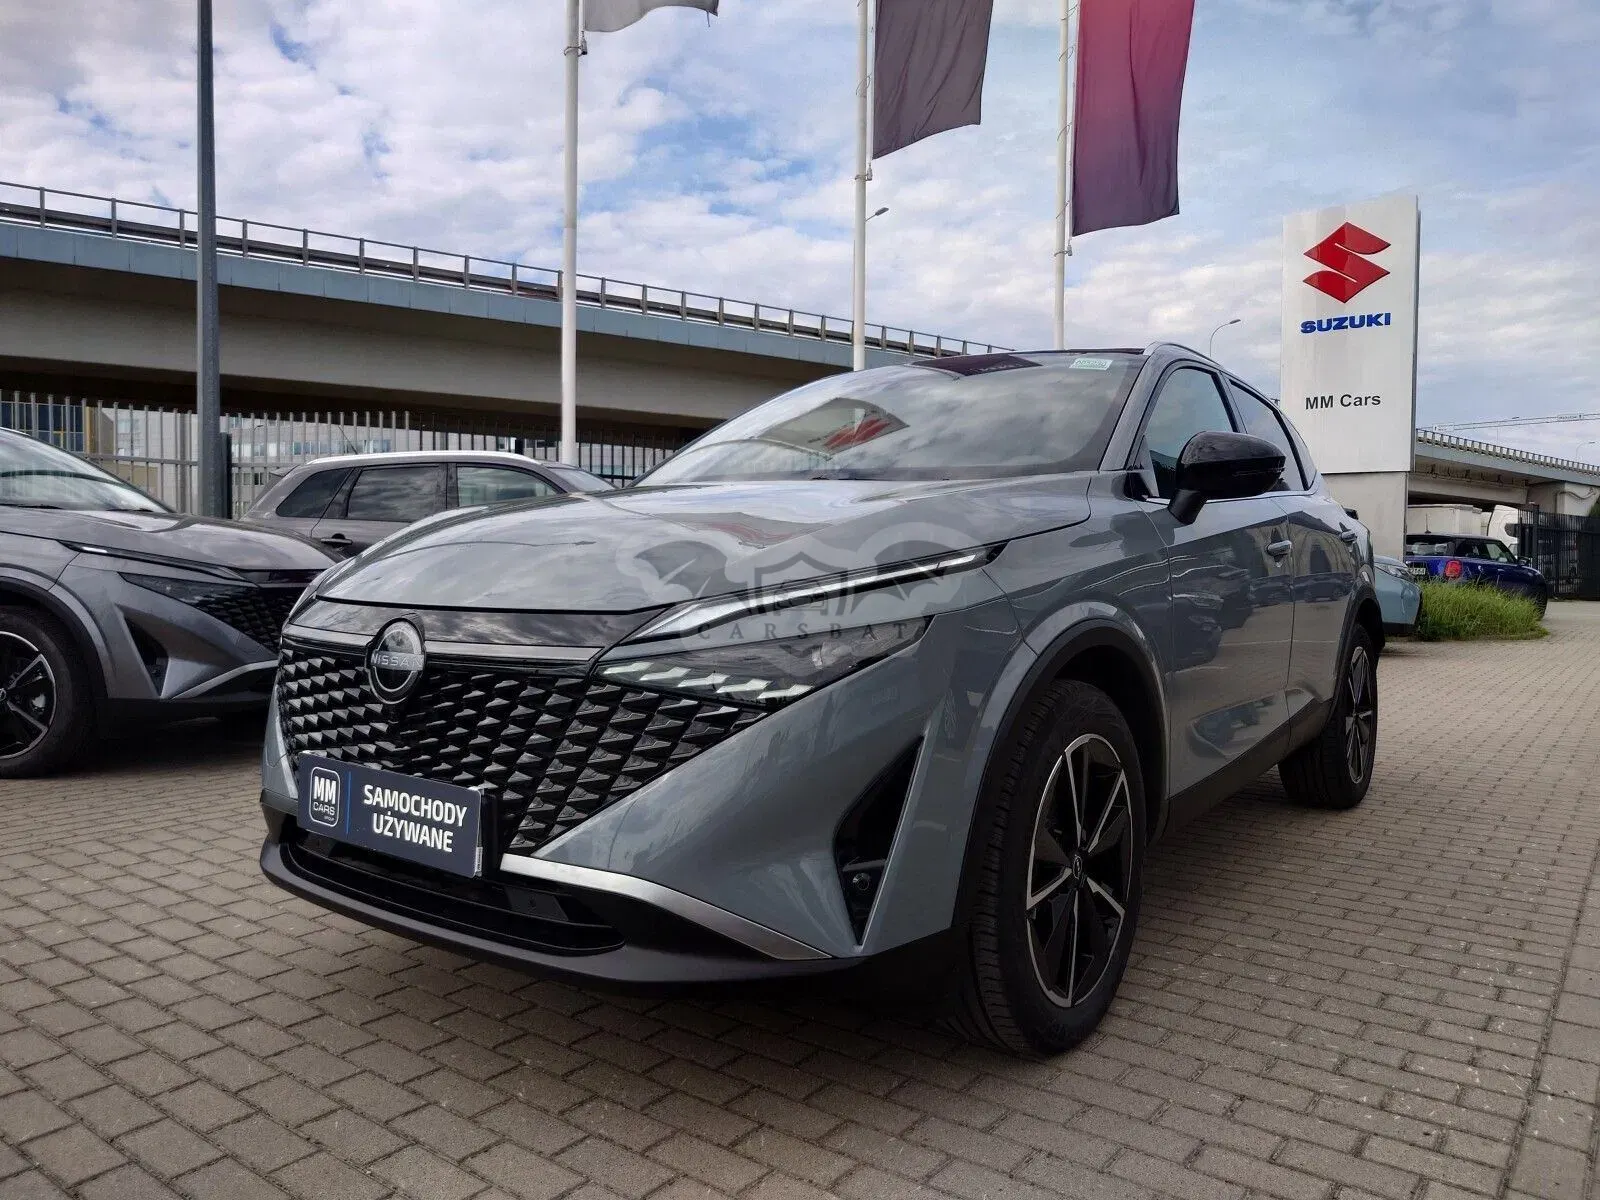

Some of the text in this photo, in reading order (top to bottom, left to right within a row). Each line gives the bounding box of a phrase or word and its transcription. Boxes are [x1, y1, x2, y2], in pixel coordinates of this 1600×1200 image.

[1300, 312, 1391, 334] SUZUKI
[1305, 394, 1381, 410] MM Cars
[370, 652, 423, 668] NISSAN
[313, 775, 337, 805] MM
[313, 801, 336, 816] CARS
[363, 784, 468, 827] SAMOCHODY
[373, 810, 454, 853] UŻYWANE
